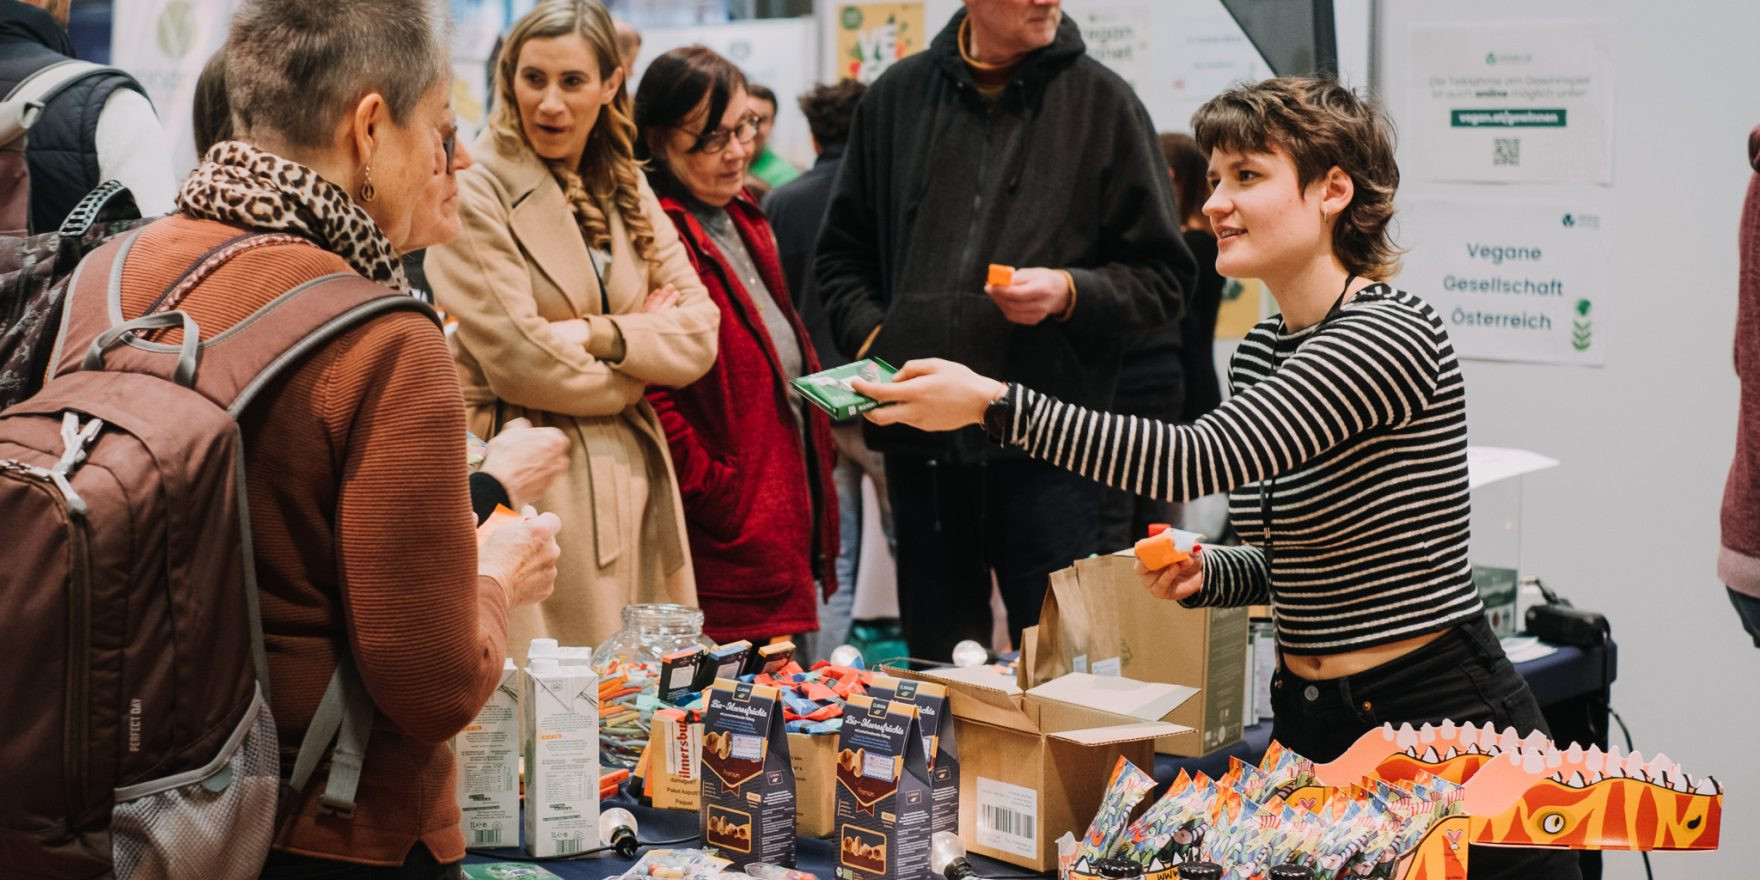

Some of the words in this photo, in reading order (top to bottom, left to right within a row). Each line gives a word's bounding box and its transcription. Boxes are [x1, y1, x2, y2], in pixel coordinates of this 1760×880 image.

[1475, 88, 1508, 98] online
[1511, 88, 1553, 101] möglich
[1458, 112, 1559, 126] vegan.at/gewinnen
[1466, 242, 1542, 264] Vegane
[1443, 275, 1563, 297] Gesellschaft
[1451, 305, 1552, 330] Österreich
[130, 698, 142, 714] DAY
[710, 699, 768, 717] Bio-Meeresfrüchte
[129, 716, 141, 752] PERFECT
[845, 714, 904, 735] Bio-Meeresfrüchte
